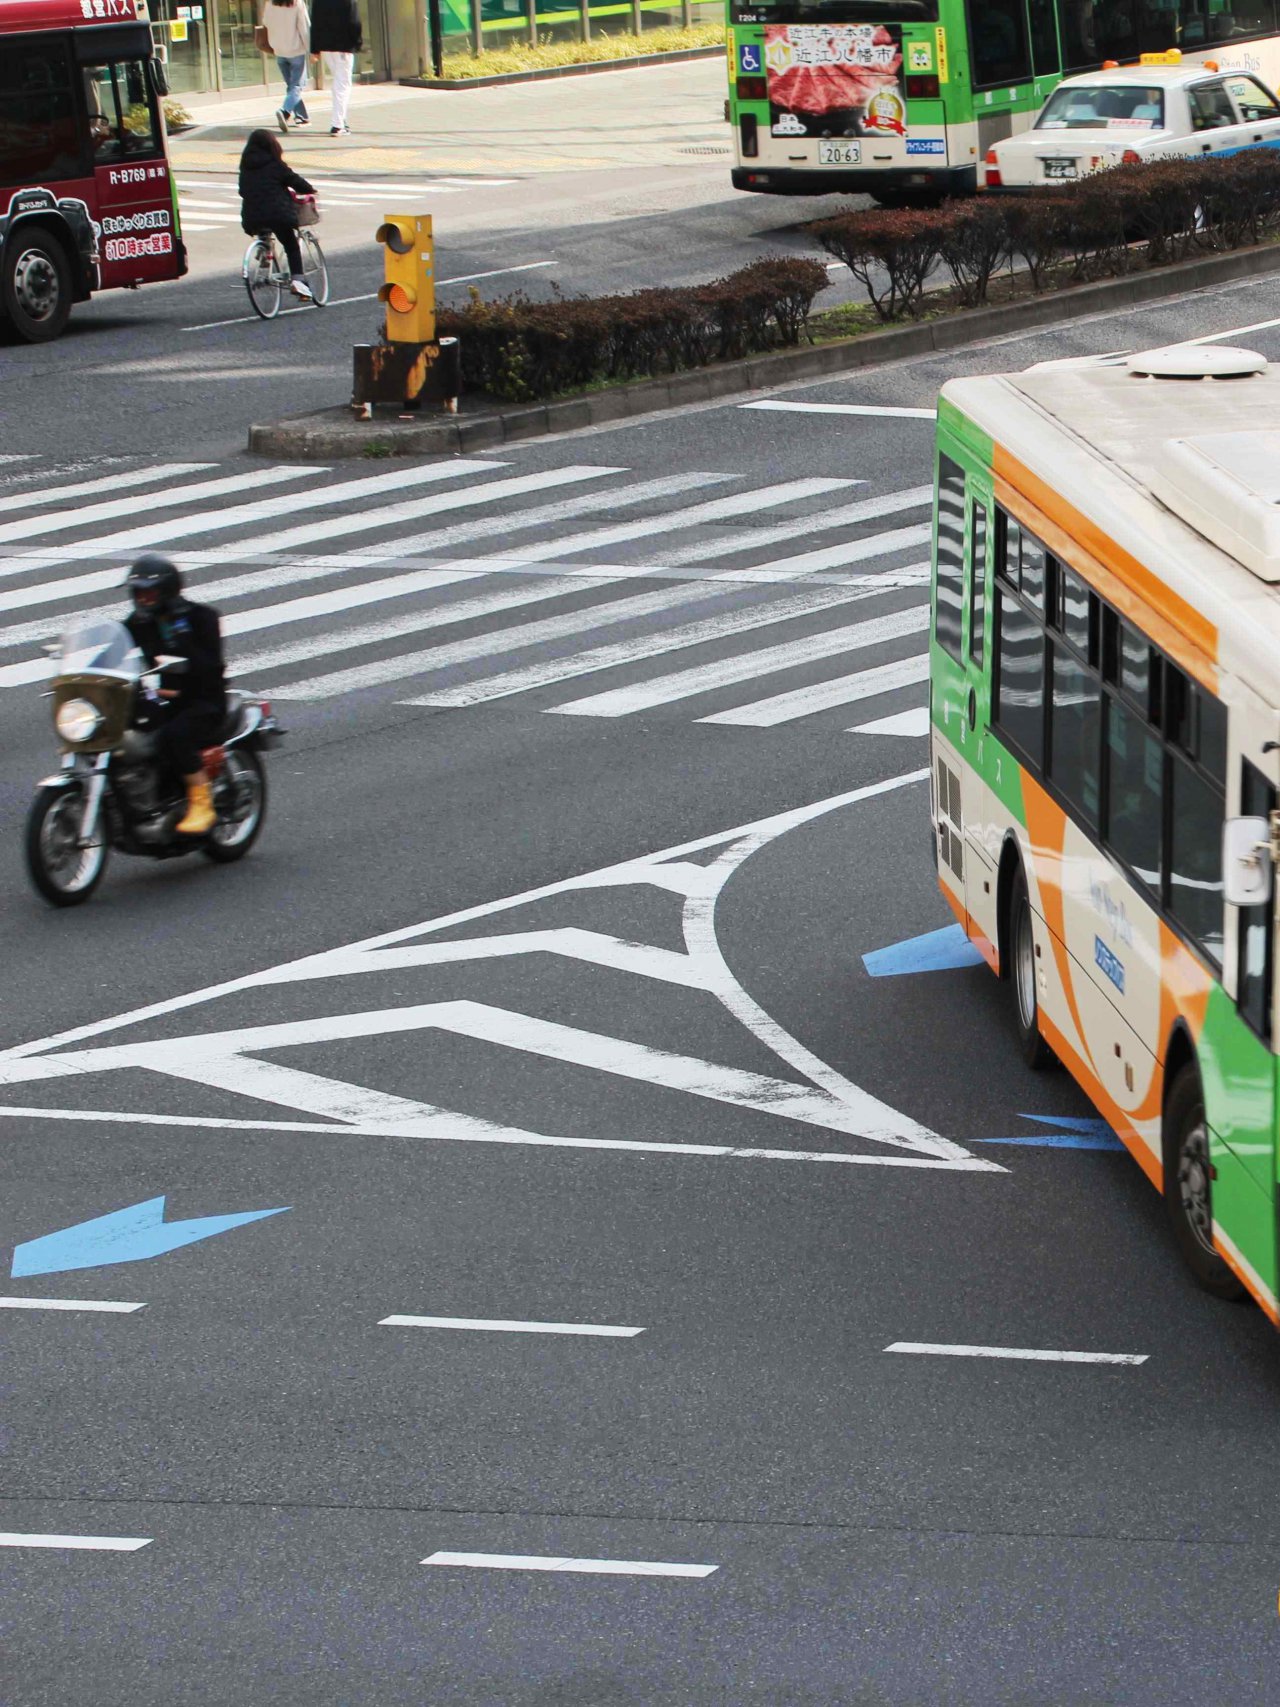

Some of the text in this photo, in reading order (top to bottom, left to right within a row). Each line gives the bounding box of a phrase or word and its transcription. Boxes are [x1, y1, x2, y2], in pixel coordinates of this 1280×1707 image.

[796, 47, 892, 64] 近江八幡市
[827, 148, 860, 163] 20-63
